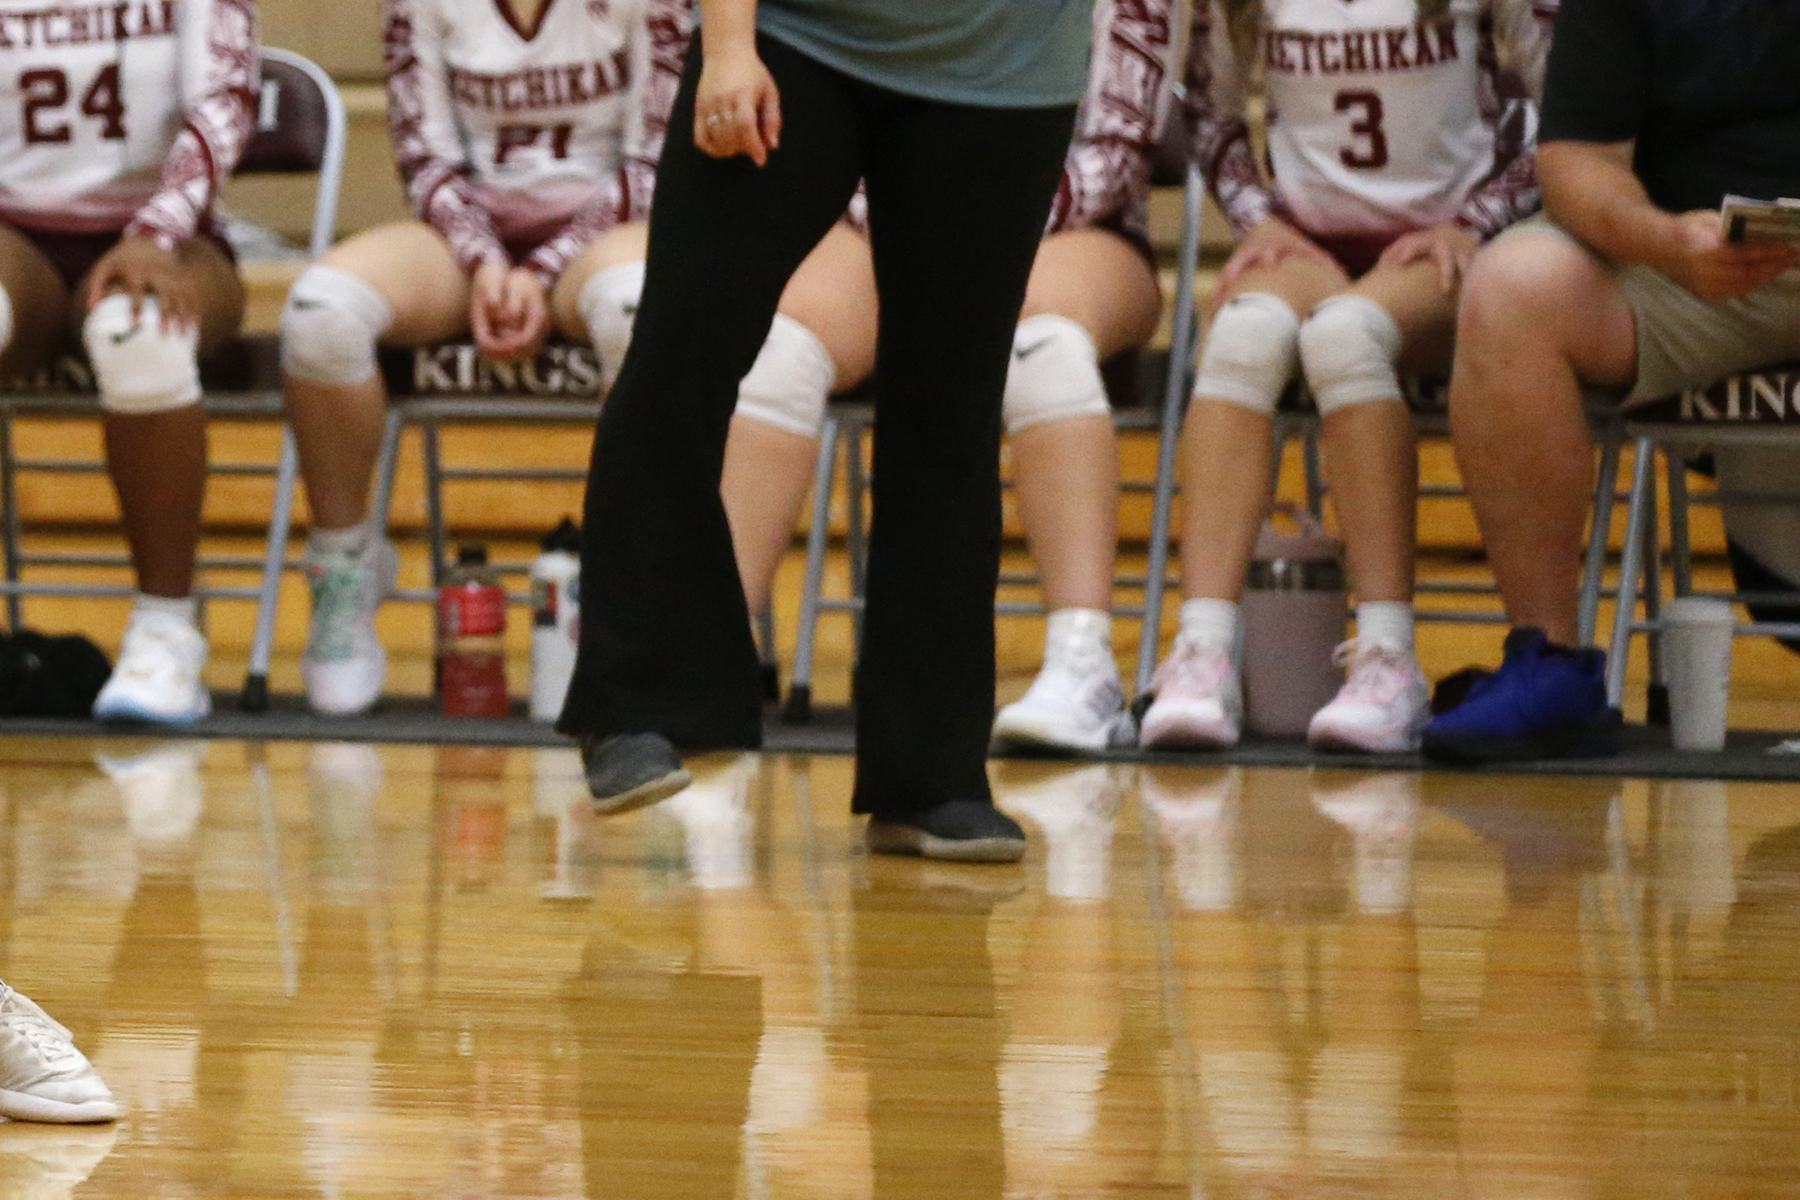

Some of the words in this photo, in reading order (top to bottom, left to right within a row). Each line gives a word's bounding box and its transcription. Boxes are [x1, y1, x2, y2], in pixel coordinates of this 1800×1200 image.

[19, 65, 126, 143] 24
[1334, 88, 1388, 168] 3
[1681, 374, 1800, 419] KIN
